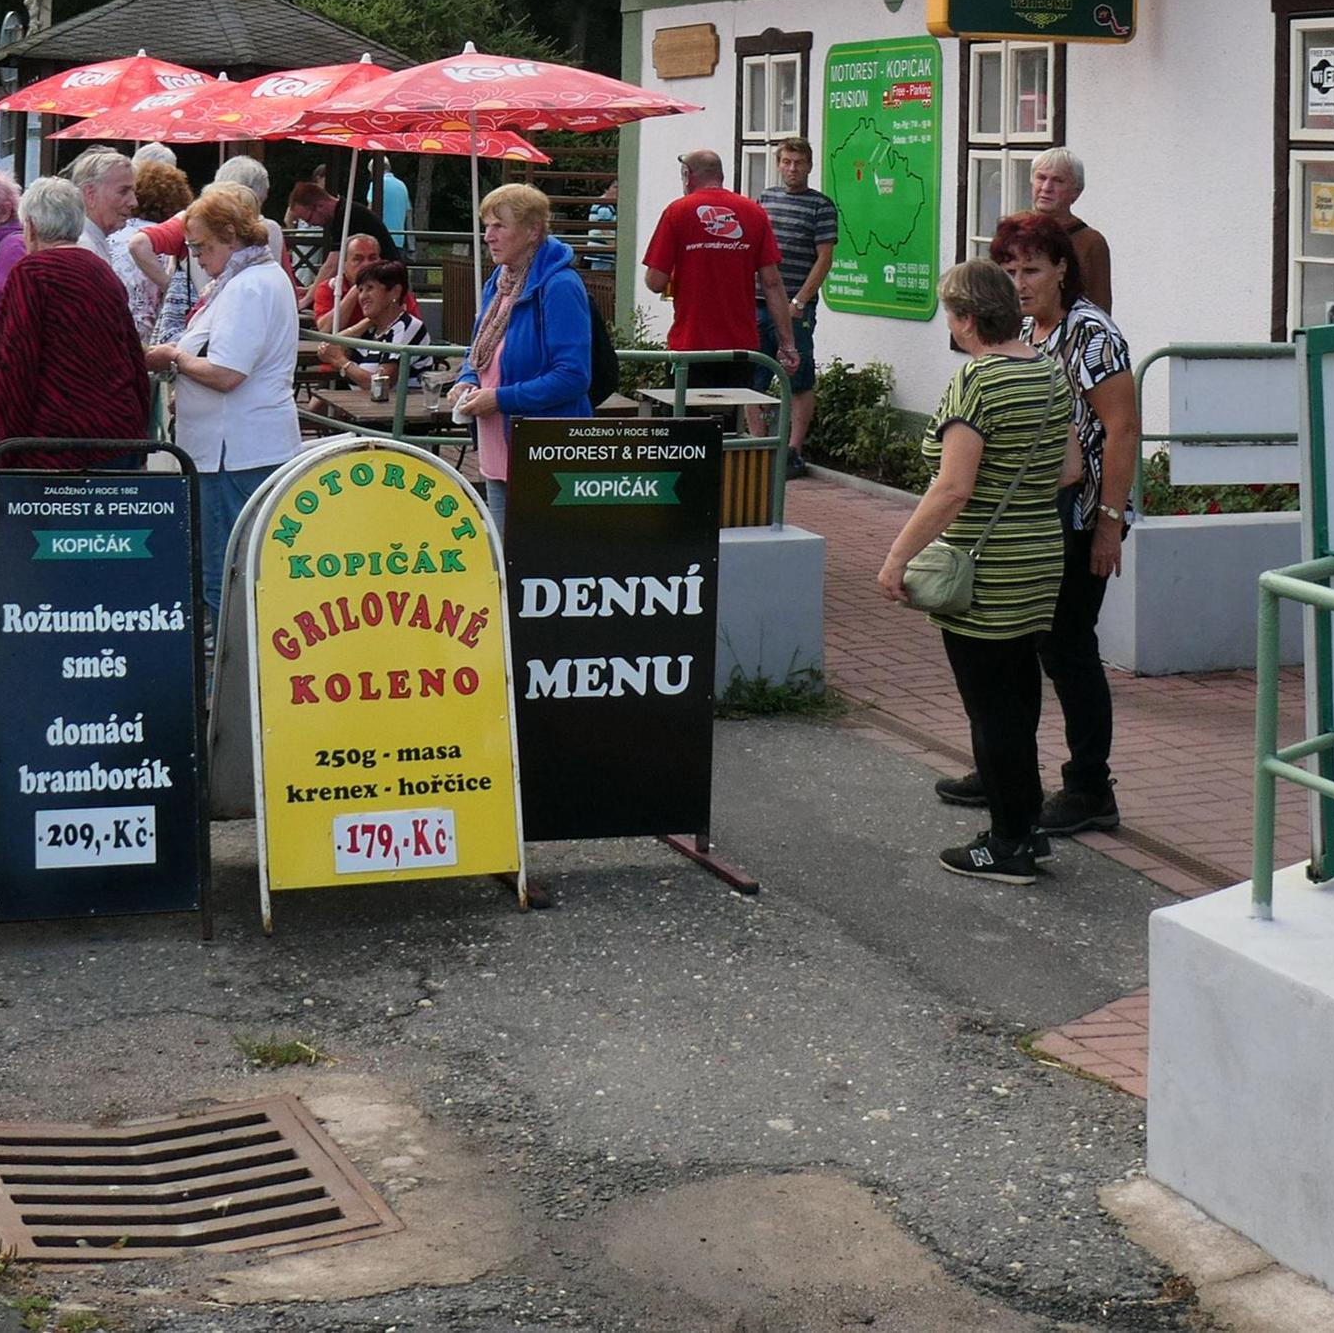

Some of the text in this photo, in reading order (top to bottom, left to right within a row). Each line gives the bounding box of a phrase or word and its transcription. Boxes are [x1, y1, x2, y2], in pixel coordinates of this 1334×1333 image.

[442, 62, 541, 83] Koli
[830, 61, 878, 83] MOTOREST
[250, 76, 332, 99] Koli
[830, 89, 868, 109] PENSION
[568, 425, 615, 437] ZALOŽENO
[624, 428, 649, 437] ROCE
[651, 428, 669, 437] 1862
[528, 444, 706, 461] MOTOREST & PENZION
[44, 486, 87, 496] ZALOŽENO
[95, 487, 119, 496] ROCE
[120, 487, 139, 495] 1862
[573, 474, 659, 498] KOPIČÁK
[7, 501, 175, 516] MOTOREST & PENZION
[272, 461, 477, 549] MOTOREST
[52, 534, 132, 554] KOPIČÁK
[288, 542, 466, 579] KOPIČÁK
[518, 564, 704, 619] DENNÍ
[1, 601, 185, 635] Rožumberská
[271, 590, 490, 661] GRILOVANÉ
[61, 647, 127, 680] směs
[289, 666, 480, 706] KOLENO
[525, 655, 694, 700] MENU
[45, 712, 145, 748] domácí
[314, 748, 377, 768] 250g
[397, 744, 463, 763] masa
[18, 761, 173, 796] bramborák
[286, 781, 379, 804] krenex
[398, 774, 492, 796] hořčice
